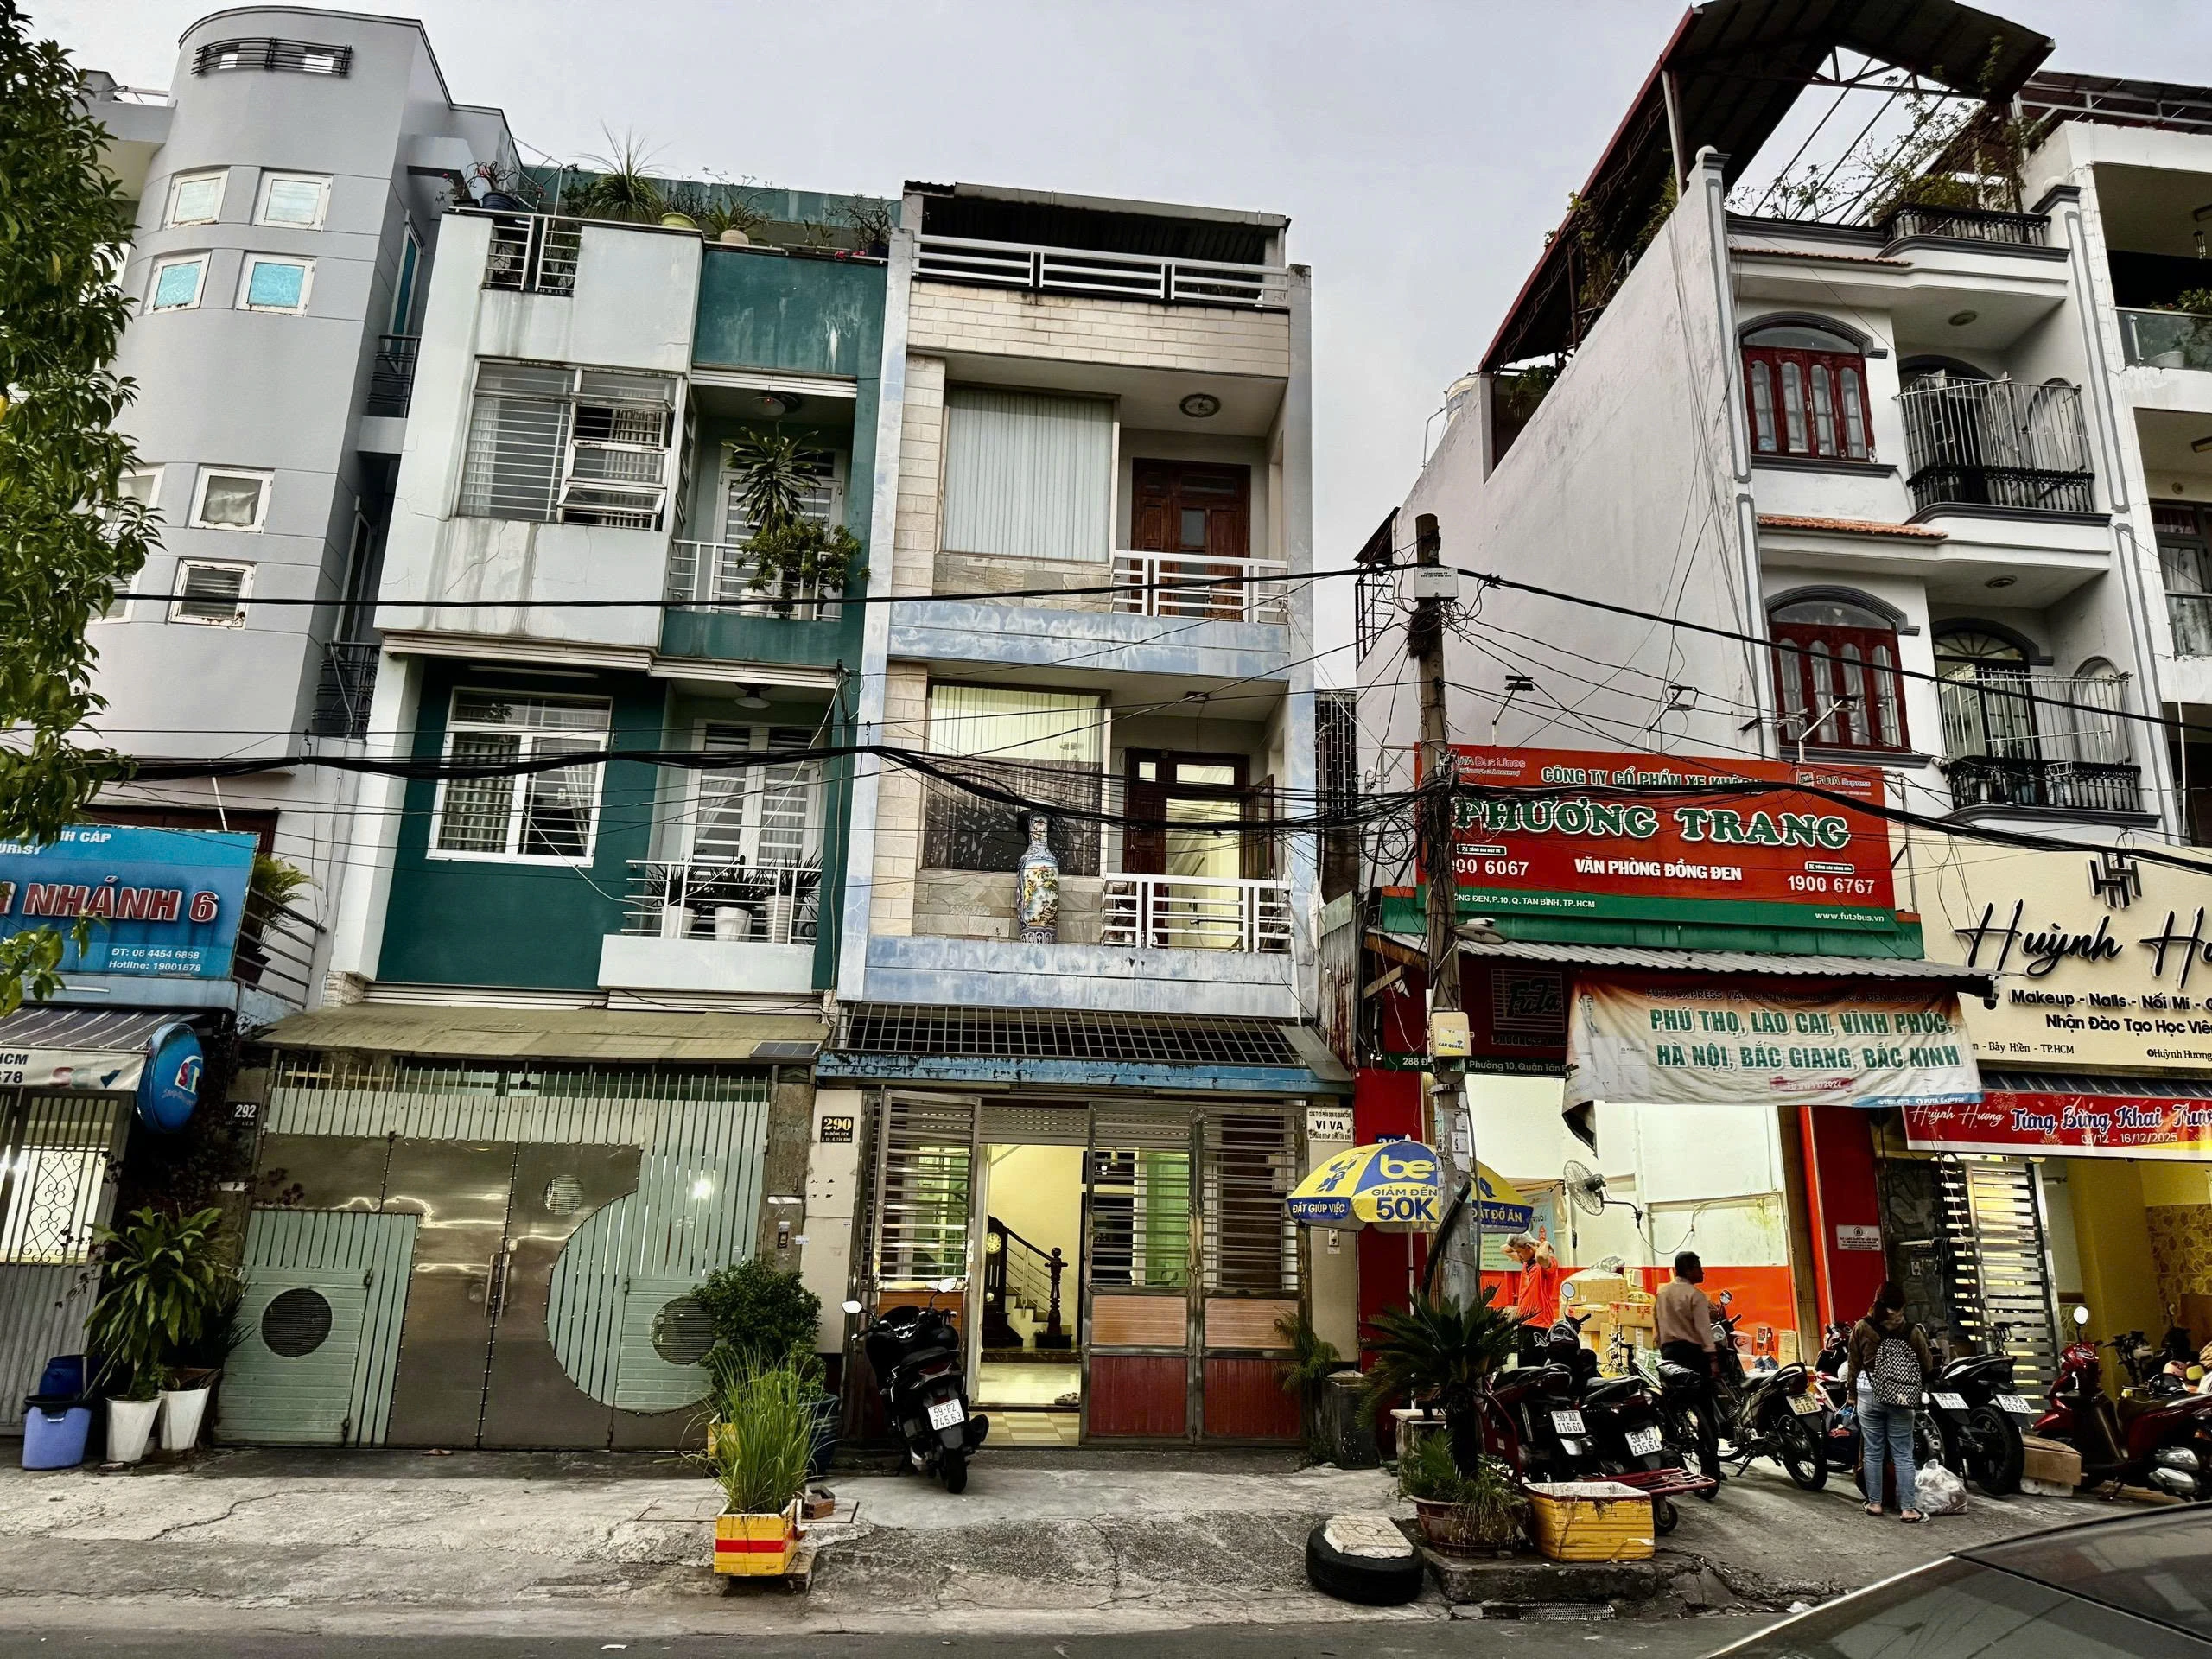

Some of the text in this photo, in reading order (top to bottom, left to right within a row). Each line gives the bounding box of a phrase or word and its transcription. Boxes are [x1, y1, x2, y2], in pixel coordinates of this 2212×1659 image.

[1541, 766, 1585, 784] CÔNG
[1588, 769, 1608, 785] TY
[1451, 796, 1852, 849] PHƯƠNG TRANG
[1484, 860, 1529, 876] 6067
[1574, 856, 1742, 880] VĂN PHÒNG ĐỒNG ĐEN
[1787, 875, 1875, 894] 1900 6767
[22, 875, 182, 921] NHÁNH
[189, 891, 219, 922] 6
[1953, 899, 2123, 978] Huỳnh
[111, 948, 130, 957] ĐT:
[148, 950, 172, 958] 4454
[175, 950, 200, 959] 6868
[108, 960, 200, 972] Hotline: 19001878
[1677, 988, 1722, 1000] EXPRESS
[2011, 990, 2075, 1007] Makeup
[2088, 993, 2127, 1008] Nails
[2139, 992, 2168, 1009] Nối
[2171, 996, 2190, 1010] Mi
[1649, 1007, 1956, 1037] PHÚ THỌ, LÀO CAI, VĨNH PHÚC,
[2045, 1014, 2084, 1033] Nhận
[2088, 1015, 2120, 1031] Đào
[2123, 1018, 2152, 1036] Tạo
[2155, 1020, 2186, 1037] Học
[1656, 1041, 1688, 1068] HÀ
[1691, 1042, 1737, 1071] NỘI,
[1738, 1039, 1785, 1070] BẮC
[1789, 1046, 1860, 1071] GIANG,
[1860, 1041, 1904, 1071] BẮC
[1989, 1041, 2005, 1053] Bảy
[2009, 1042, 2031, 1052] Hiền
[2040, 1044, 2074, 1053] TP.HCM
[1469, 1059, 1503, 1071] Phường
[1518, 1062, 1543, 1072] Quận
[234, 1104, 257, 1118] 292
[1909, 1103, 1955, 1126] Huỳnh
[2011, 1108, 2056, 1134] Tưng
[2060, 1105, 2112, 1134] Bừng
[2116, 1105, 2164, 1128] Khai
[823, 1117, 852, 1131] 290
[1315, 1120, 1344, 1130] VI VA
[2120, 1132, 2178, 1144] 16/12/2025
[1380, 1154, 1435, 1179] be
[1371, 1185, 1437, 1197] GIẢM ĐẾN
[1293, 1201, 1345, 1217] ĐẶT GIÚP VIỆC
[1376, 1196, 1436, 1221] 50K
[1507, 1209, 1522, 1223] ĂN
[933, 1402, 957, 1418] 59-P2
